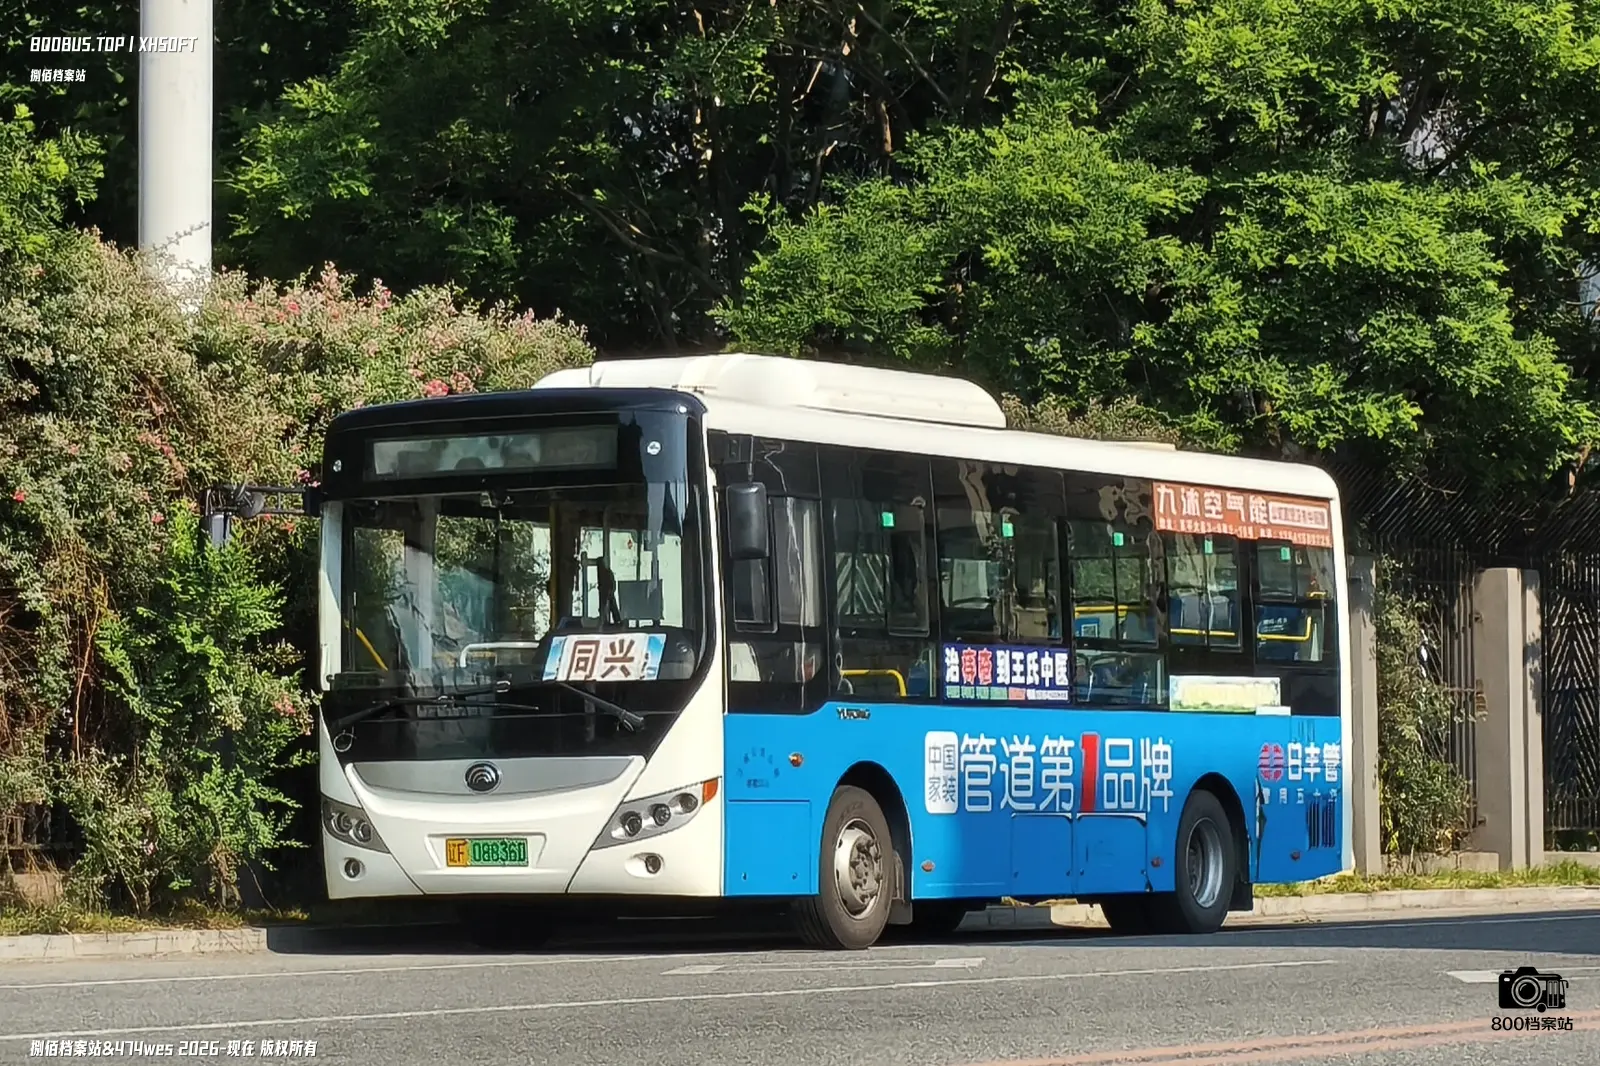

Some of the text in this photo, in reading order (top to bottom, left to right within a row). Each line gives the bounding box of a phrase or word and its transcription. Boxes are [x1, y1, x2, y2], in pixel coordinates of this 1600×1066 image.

[568, 638, 635, 682] 同兴
[928, 743, 957, 771] 中国
[960, 732, 1174, 813] 管道第1品牌
[928, 774, 957, 804] 家装
